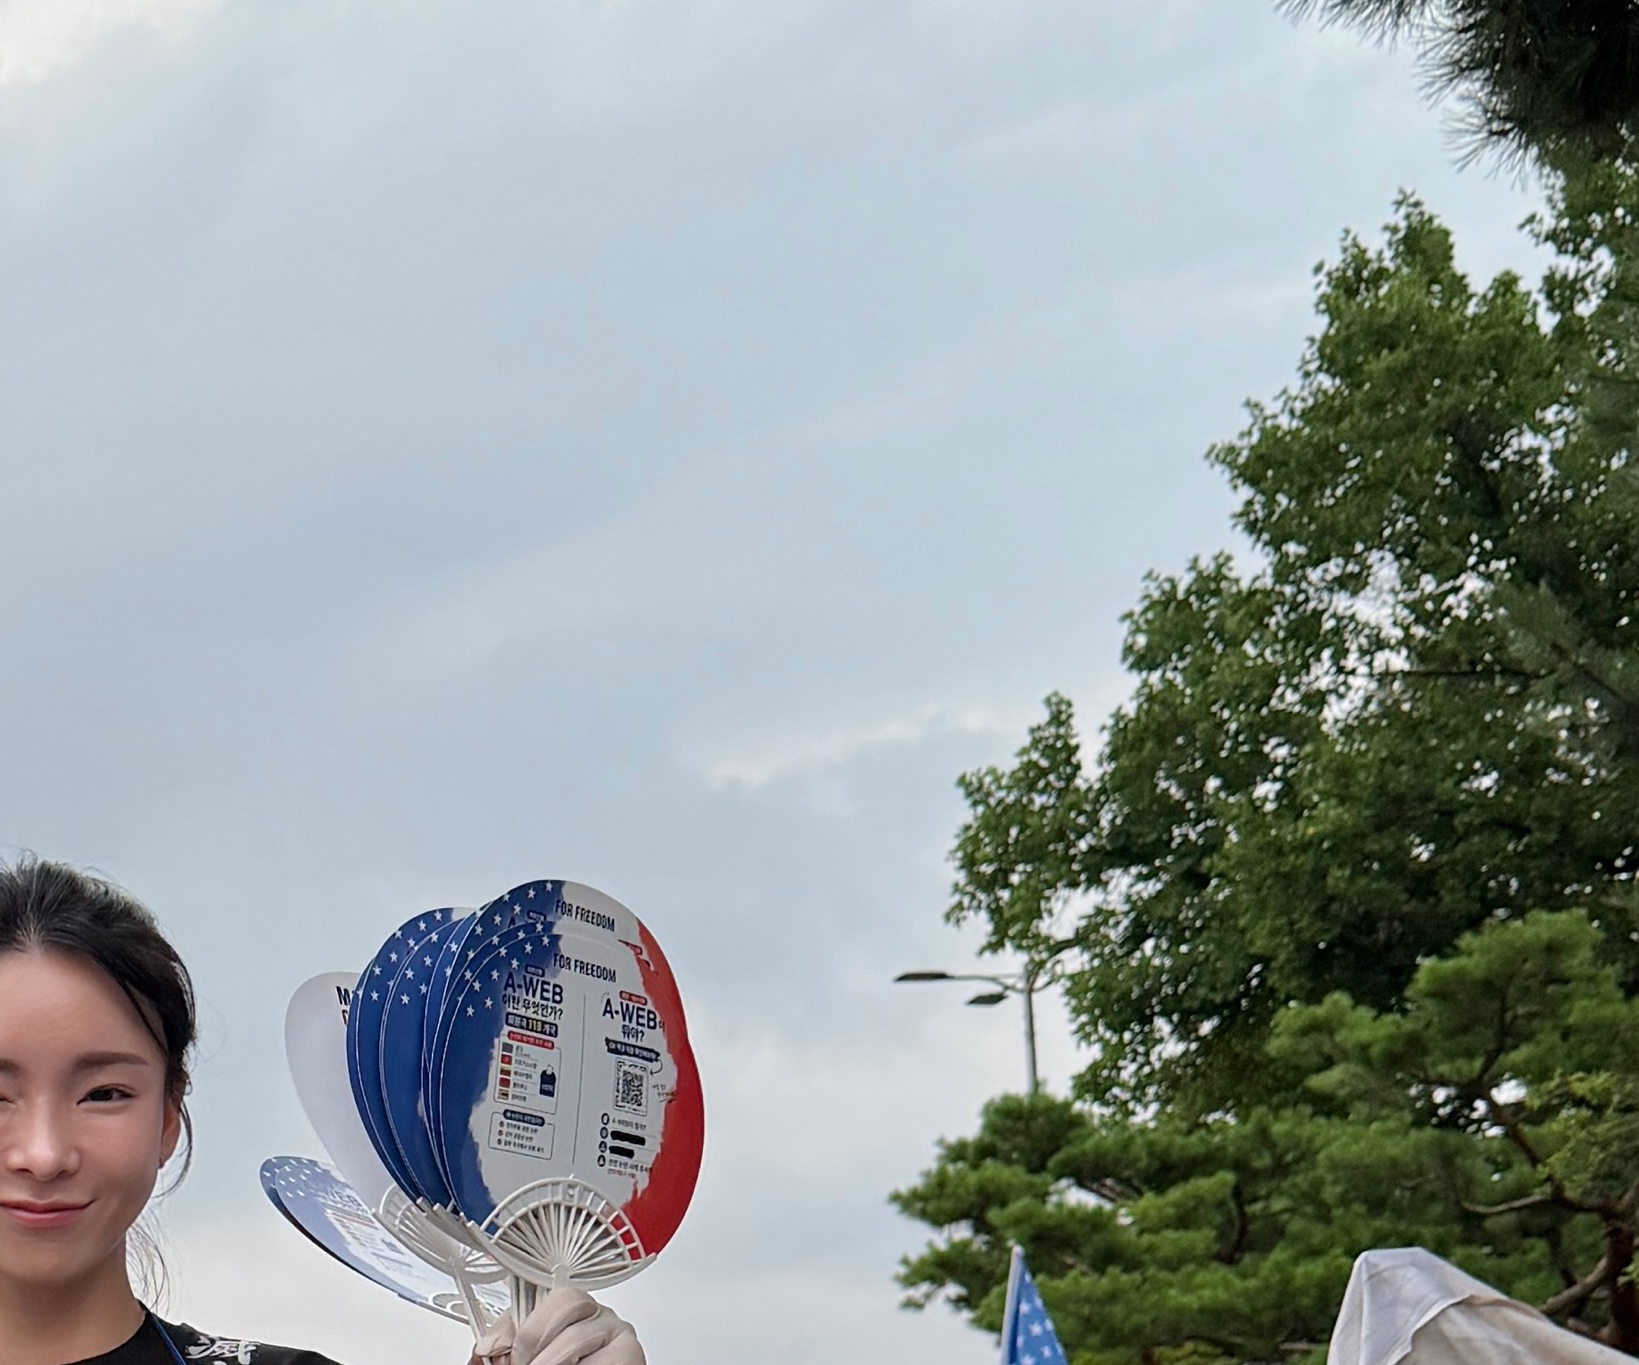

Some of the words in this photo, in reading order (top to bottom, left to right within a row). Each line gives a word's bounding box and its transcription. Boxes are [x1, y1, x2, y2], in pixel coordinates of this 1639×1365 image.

[555, 900, 573, 917] FOR
[575, 905, 615, 931] FREEDOM
[554, 953, 572, 970] FOR
[574, 959, 616, 982] FREEDOM
[504, 972, 564, 1004] A-WEB
